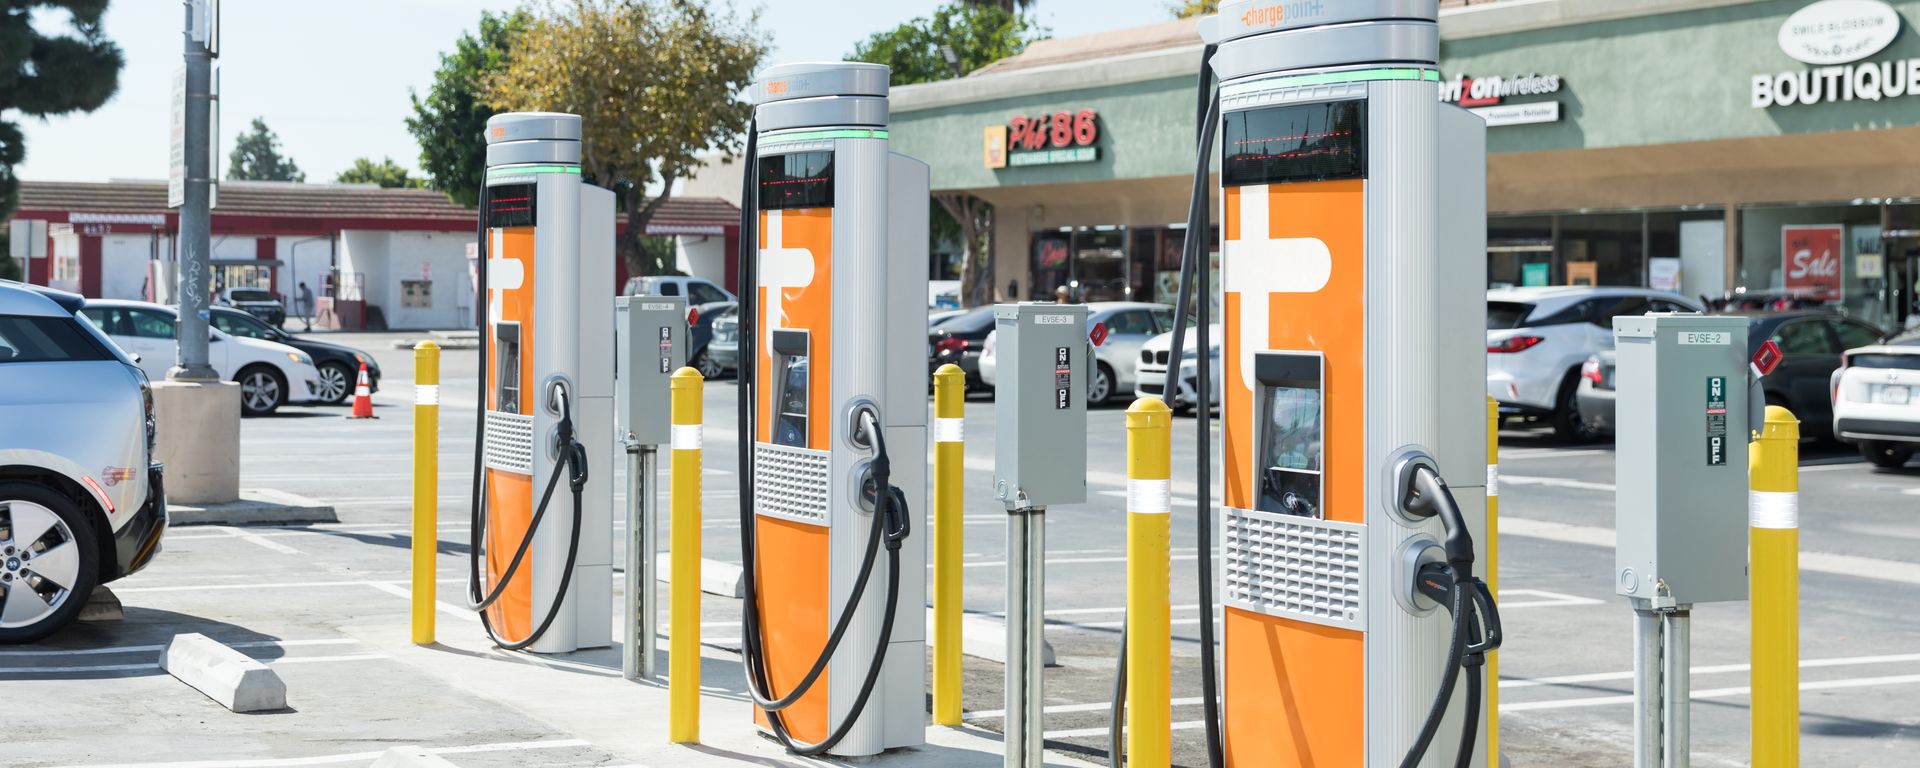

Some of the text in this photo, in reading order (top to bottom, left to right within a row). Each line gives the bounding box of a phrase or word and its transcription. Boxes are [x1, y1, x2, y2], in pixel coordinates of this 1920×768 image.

[1827, 17, 1885, 32] BLOSSOM
[1751, 58, 1920, 108] BOUTIQUE
[1050, 108, 1096, 148] 86
[1789, 249, 1838, 279] Sale
[1042, 315, 1067, 324] EVSE-3
[1688, 333, 1721, 344] EVSE-2
[1711, 378, 1721, 396] ON
[1711, 437, 1721, 465] OFF
